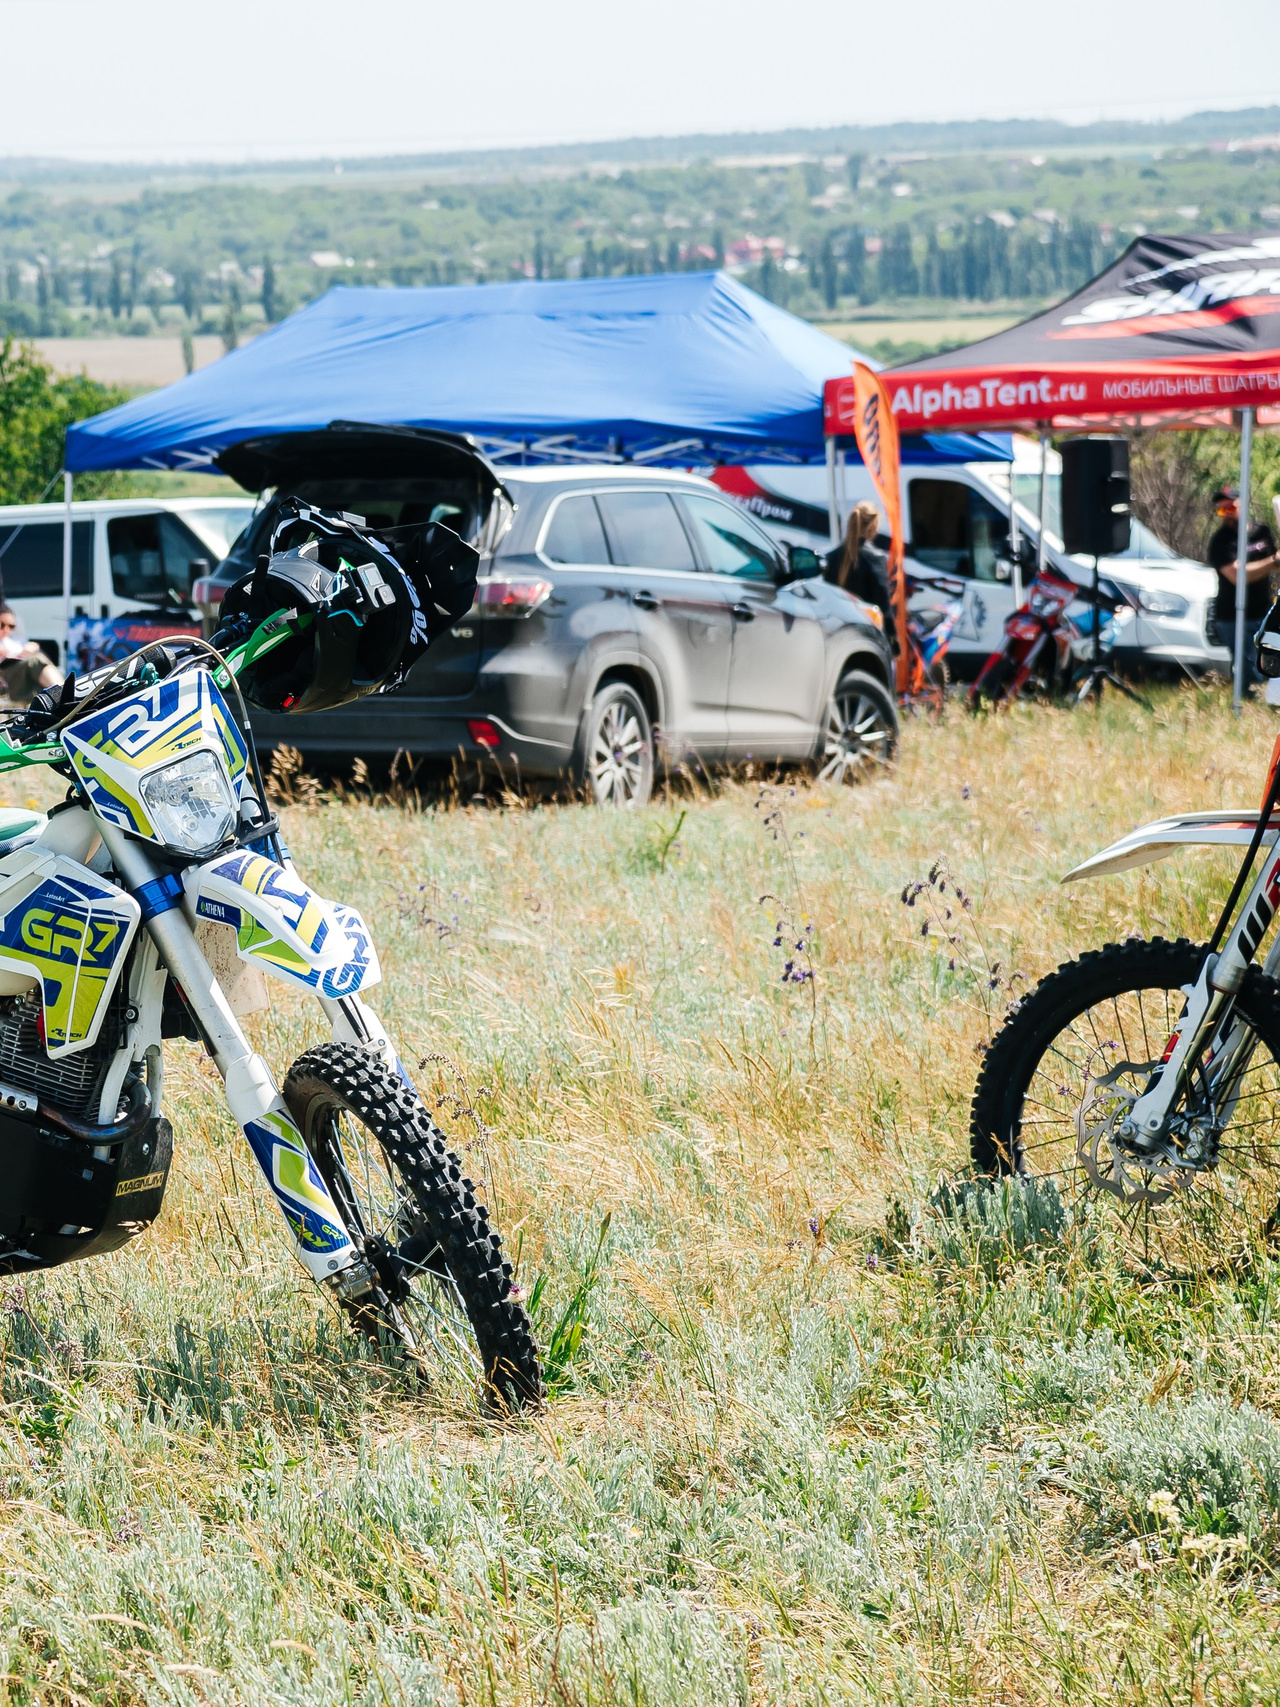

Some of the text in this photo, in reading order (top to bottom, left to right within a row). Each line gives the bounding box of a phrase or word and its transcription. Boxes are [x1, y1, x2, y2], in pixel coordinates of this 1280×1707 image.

[891, 377, 1086, 419] AlphaTent.ru
[1102, 376, 1215, 399] МОБИЛЬНЫЕ
[450, 627, 474, 638] V6
[205, 901, 225, 918] ATHENA
[21, 908, 120, 962] GR7
[118, 1173, 164, 1193] MAGNUM
